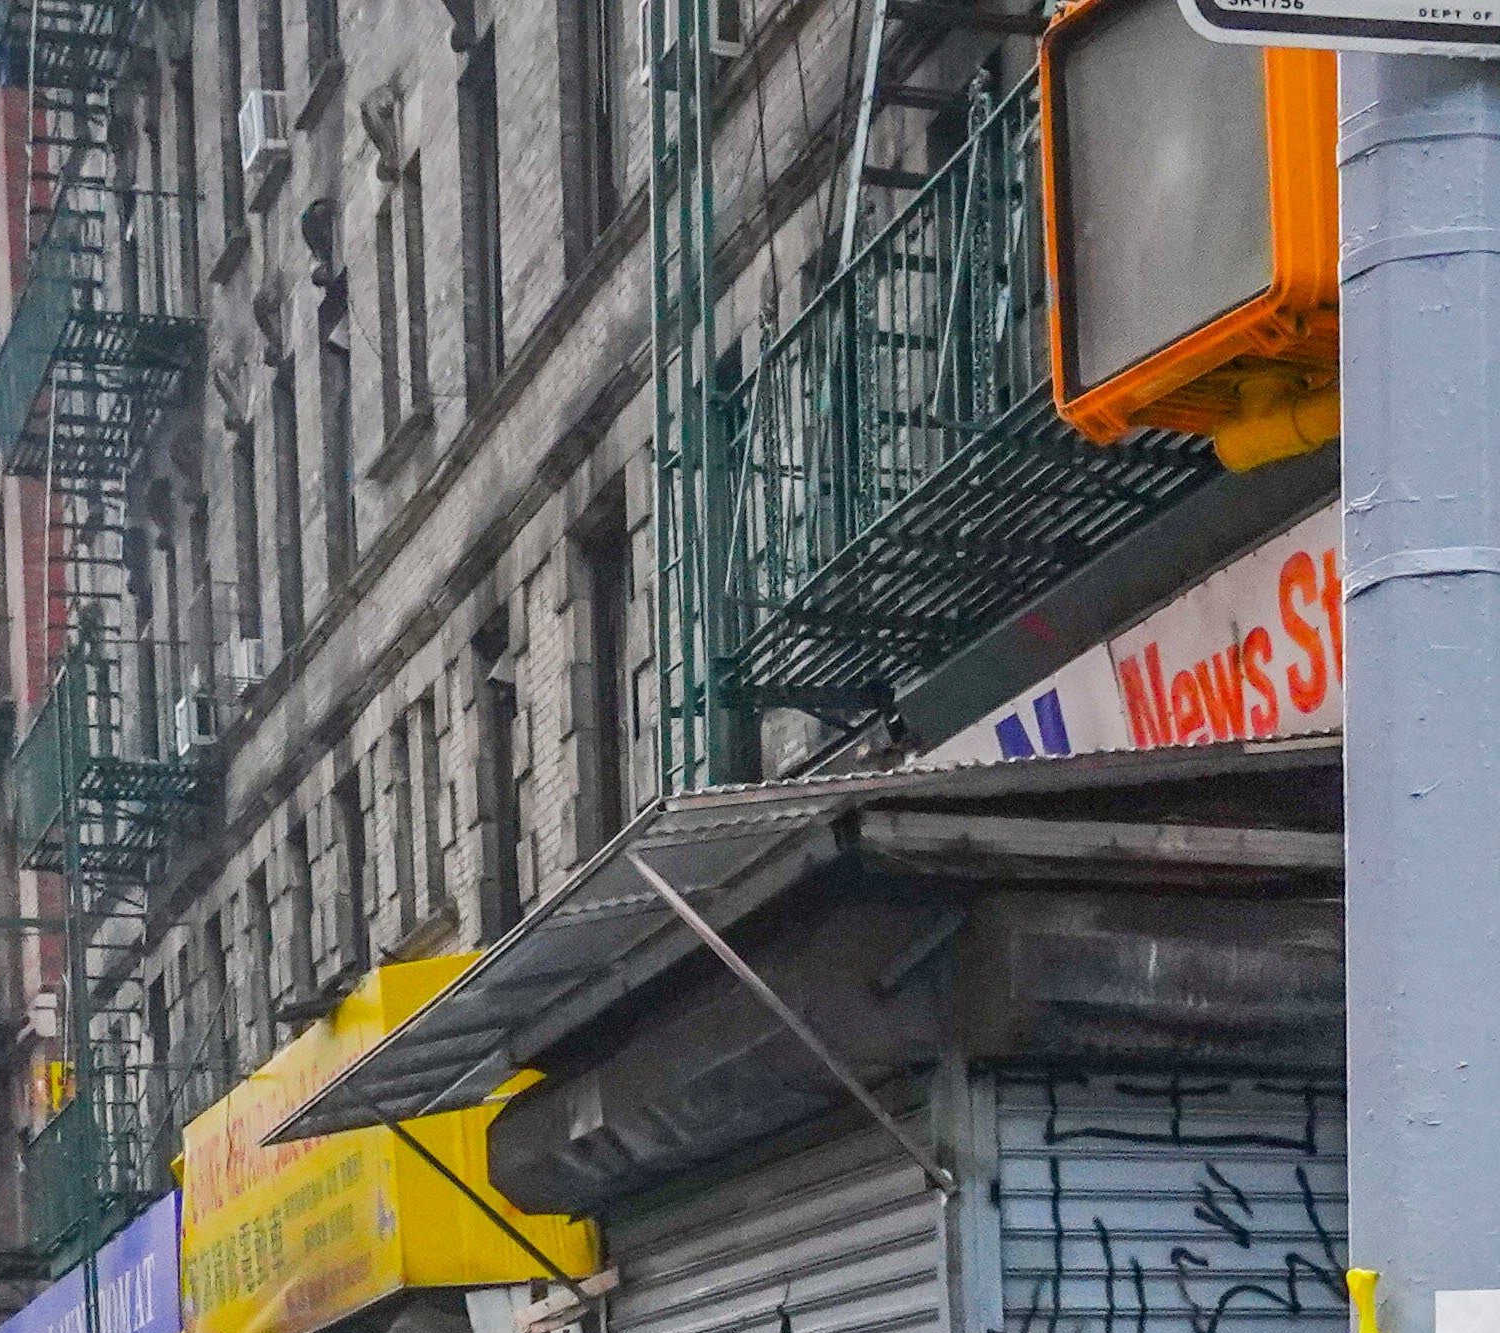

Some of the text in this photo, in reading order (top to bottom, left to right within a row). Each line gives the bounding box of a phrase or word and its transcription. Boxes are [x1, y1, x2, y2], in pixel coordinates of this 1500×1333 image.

[1418, 7, 1464, 21] DEPT
[1472, 10, 1494, 22] OF
[1119, 626, 1280, 749] News
